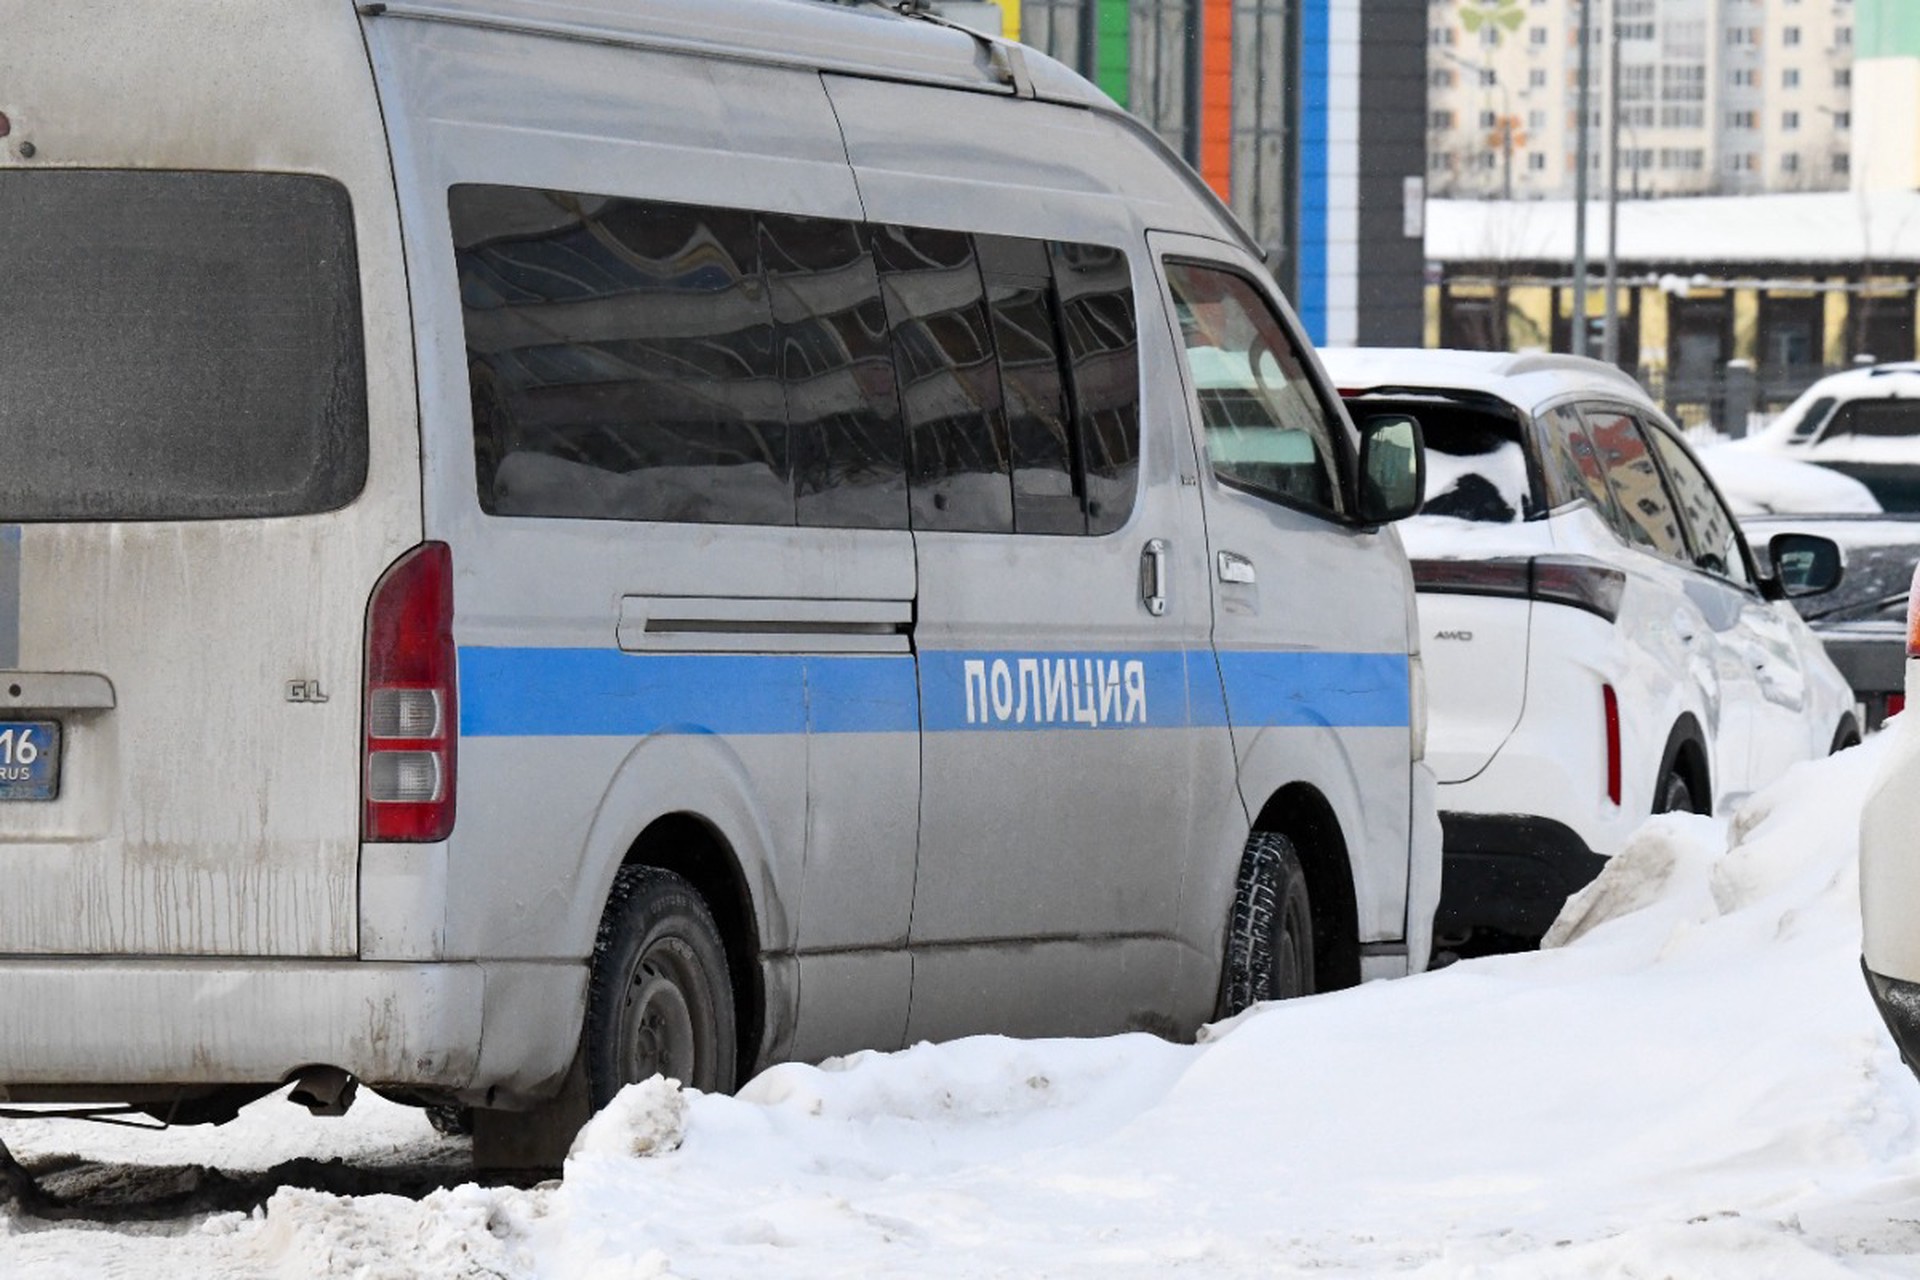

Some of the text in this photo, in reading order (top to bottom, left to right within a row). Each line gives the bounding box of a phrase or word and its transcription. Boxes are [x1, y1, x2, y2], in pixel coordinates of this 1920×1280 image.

[1434, 630, 1473, 641] AWD
[285, 679, 330, 704] GL
[964, 658, 1147, 728] ПОЛИЦИЯ
[0, 728, 38, 764] 16
[0, 767, 31, 780] RUS
